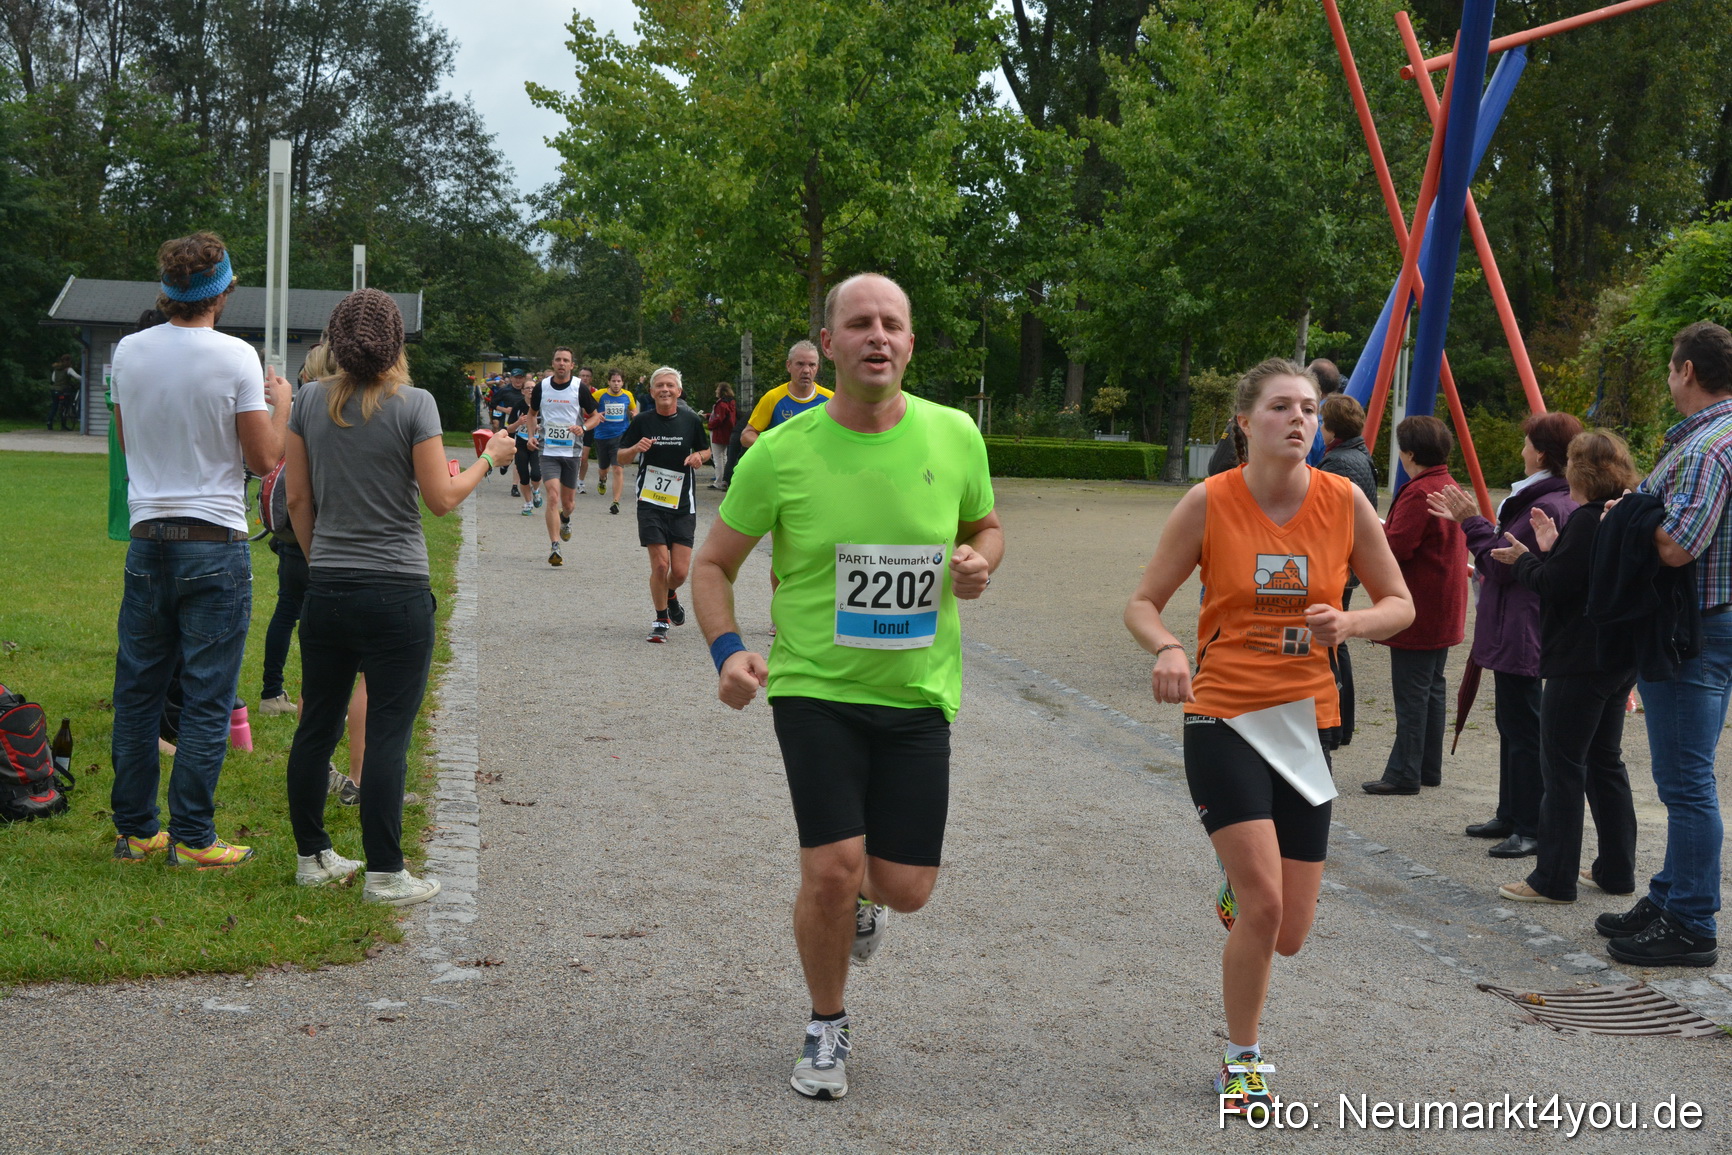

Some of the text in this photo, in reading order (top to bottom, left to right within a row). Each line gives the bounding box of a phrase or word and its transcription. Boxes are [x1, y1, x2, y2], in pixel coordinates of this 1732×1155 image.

[548, 427, 571, 439] 2537
[655, 476, 672, 493] 37
[652, 492, 667, 502] Franz
[838, 553, 930, 566] PARTL Neumarkt
[847, 570, 935, 609] 2202
[1255, 596, 1307, 606] HIRSCH
[873, 620, 910, 635] Ionut
